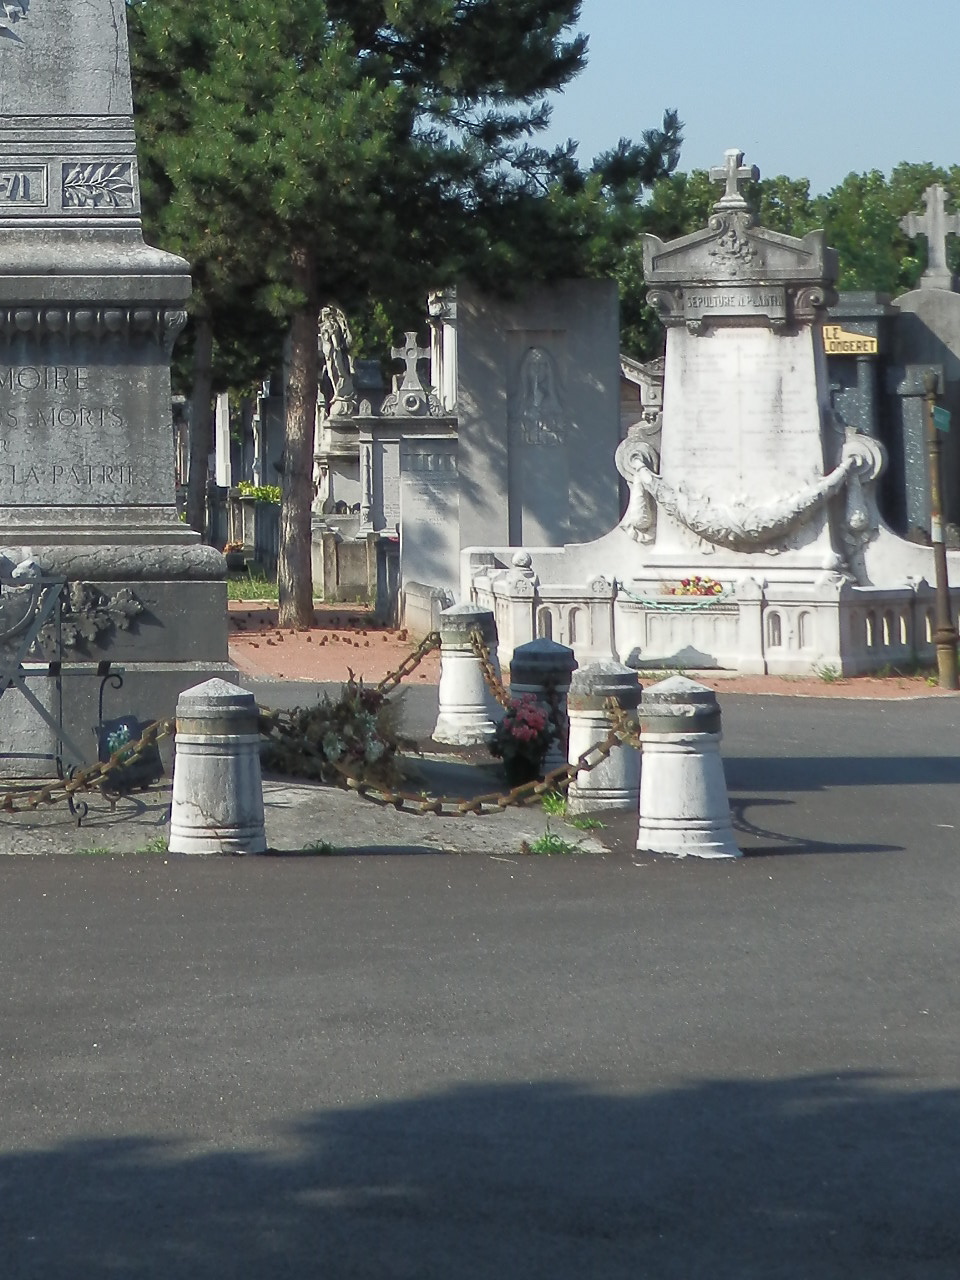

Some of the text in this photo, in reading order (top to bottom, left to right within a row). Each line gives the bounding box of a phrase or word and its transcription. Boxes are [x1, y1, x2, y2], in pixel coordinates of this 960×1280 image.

[825, 327, 840, 340] LE
[37, 407, 124, 428] MORTS
[11, 465, 40, 485] LA
